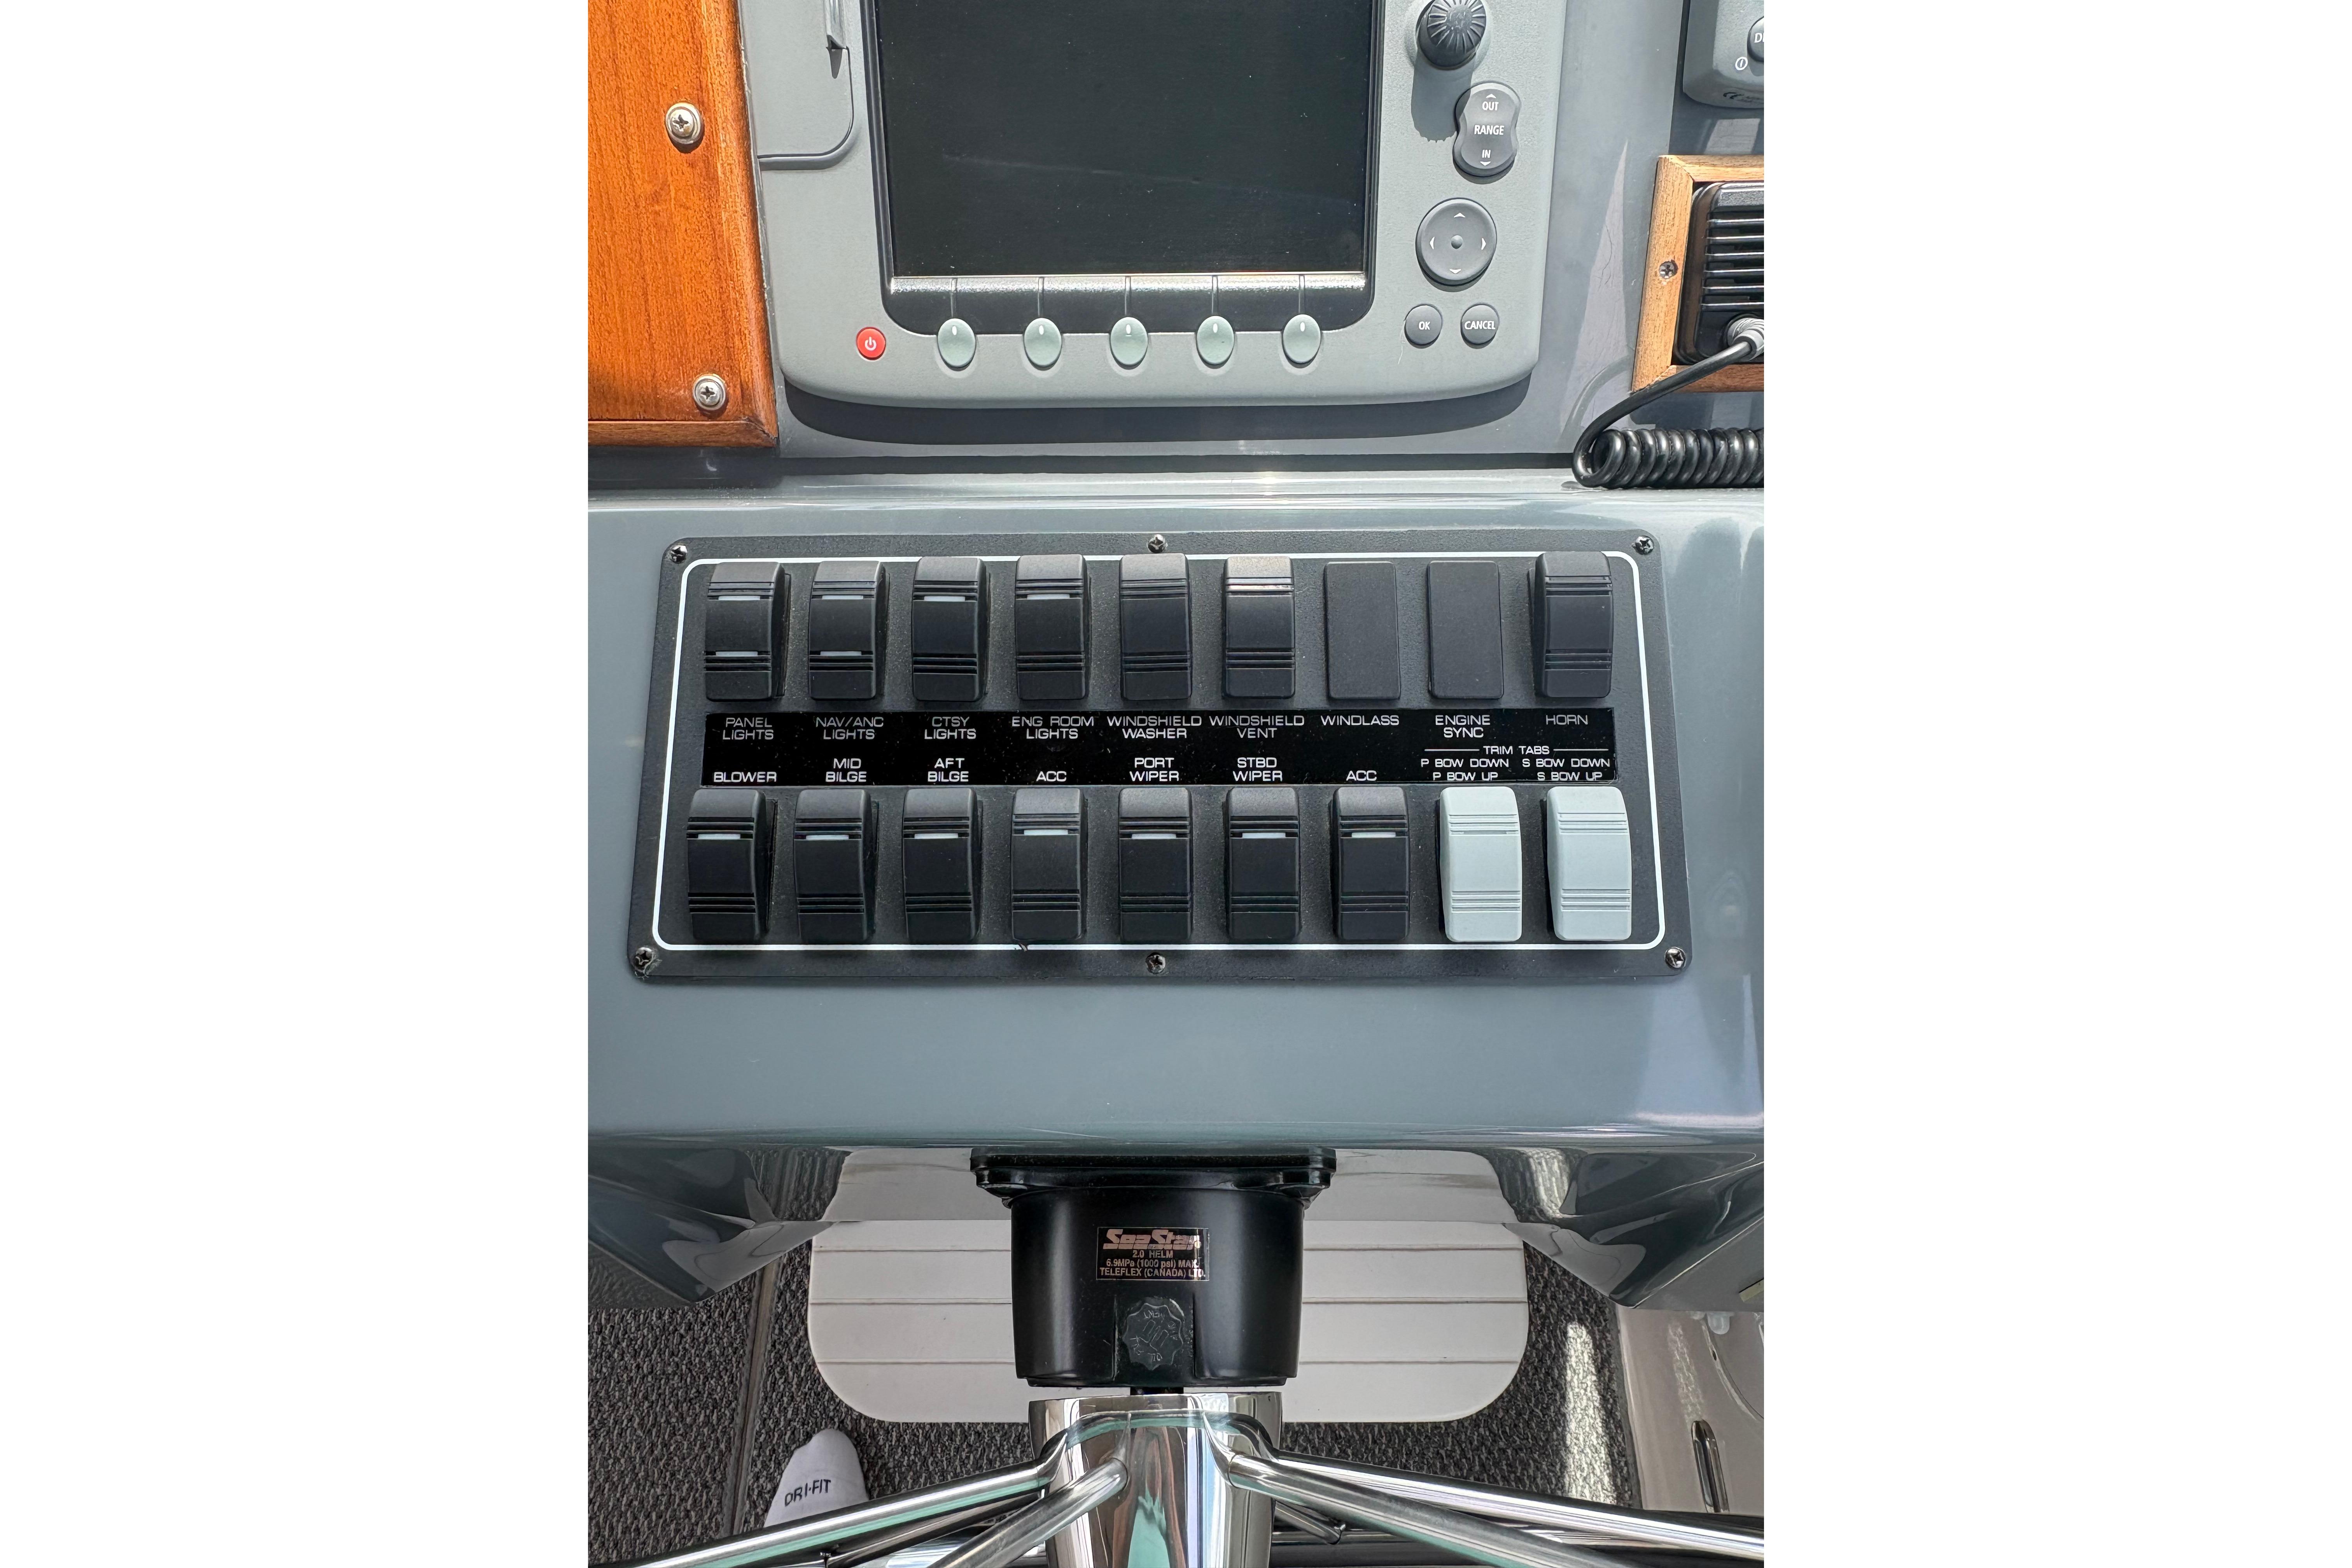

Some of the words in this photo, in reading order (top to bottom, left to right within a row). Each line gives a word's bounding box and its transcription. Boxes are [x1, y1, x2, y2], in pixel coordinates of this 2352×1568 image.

[1482, 101, 1499, 110] OUT
[1474, 124, 1505, 135] RANGE
[1482, 149, 1491, 158] IN
[1418, 321, 1431, 330] OK
[1464, 320, 1496, 330] CANCEL
[726, 717, 772, 727] PANEL
[816, 717, 884, 727] NAV/ANC
[932, 716, 970, 727] CTSY
[1012, 716, 1043, 727] ENG
[1050, 716, 1094, 726] ROOM
[1107, 716, 1202, 726] WINDSHIELD
[1209, 715, 1304, 726] WINDSHIELD
[1320, 715, 1399, 726] WINDLASS
[1435, 715, 1491, 725] ENGINE
[1546, 714, 1588, 725] HORN
[723, 729, 774, 740] LIGHTS
[823, 729, 875, 740] LIGHTS
[924, 728, 976, 739] LIGHTS
[1026, 728, 1078, 739] LIGHTS
[1122, 728, 1187, 739] WASHER
[1237, 728, 1278, 738] VENT
[1444, 727, 1484, 738] SYNC
[1483, 746, 1513, 755] TRIM
[1518, 746, 1550, 755] TABS
[833, 758, 861, 769] MID
[934, 758, 965, 768] AFT
[1134, 757, 1174, 768] PORT
[1237, 757, 1277, 768] STBD
[1421, 758, 1430, 767] P
[1435, 758, 1464, 768] BOW
[1470, 758, 1509, 768] DOWN
[1522, 758, 1530, 767] S
[1536, 758, 1565, 767] BOW
[1571, 758, 1610, 767] DOWN
[713, 772, 777, 782] BLOWER
[825, 771, 867, 782] BILGE
[928, 771, 969, 782] BILGE
[1036, 771, 1067, 782] ACC
[1129, 770, 1179, 782] WIPER
[1232, 770, 1283, 782] WIPER
[1346, 770, 1377, 781] ACC
[1433, 772, 1441, 781] P
[1446, 772, 1476, 782] BOW
[1480, 772, 1499, 781] UP
[1536, 772, 1545, 781] S
[1550, 772, 1580, 781] BOW
[1585, 772, 1603, 781] UP
[1132, 1250, 1144, 1258] 2.0
[1149, 1250, 1173, 1258] HELM
[1137, 1259, 1158, 1268] (1000
[1160, 1259, 1176, 1269] psi)
[1099, 1267, 1142, 1276] TELEFLEX
[1144, 1268, 1186, 1278] (CANADA)
